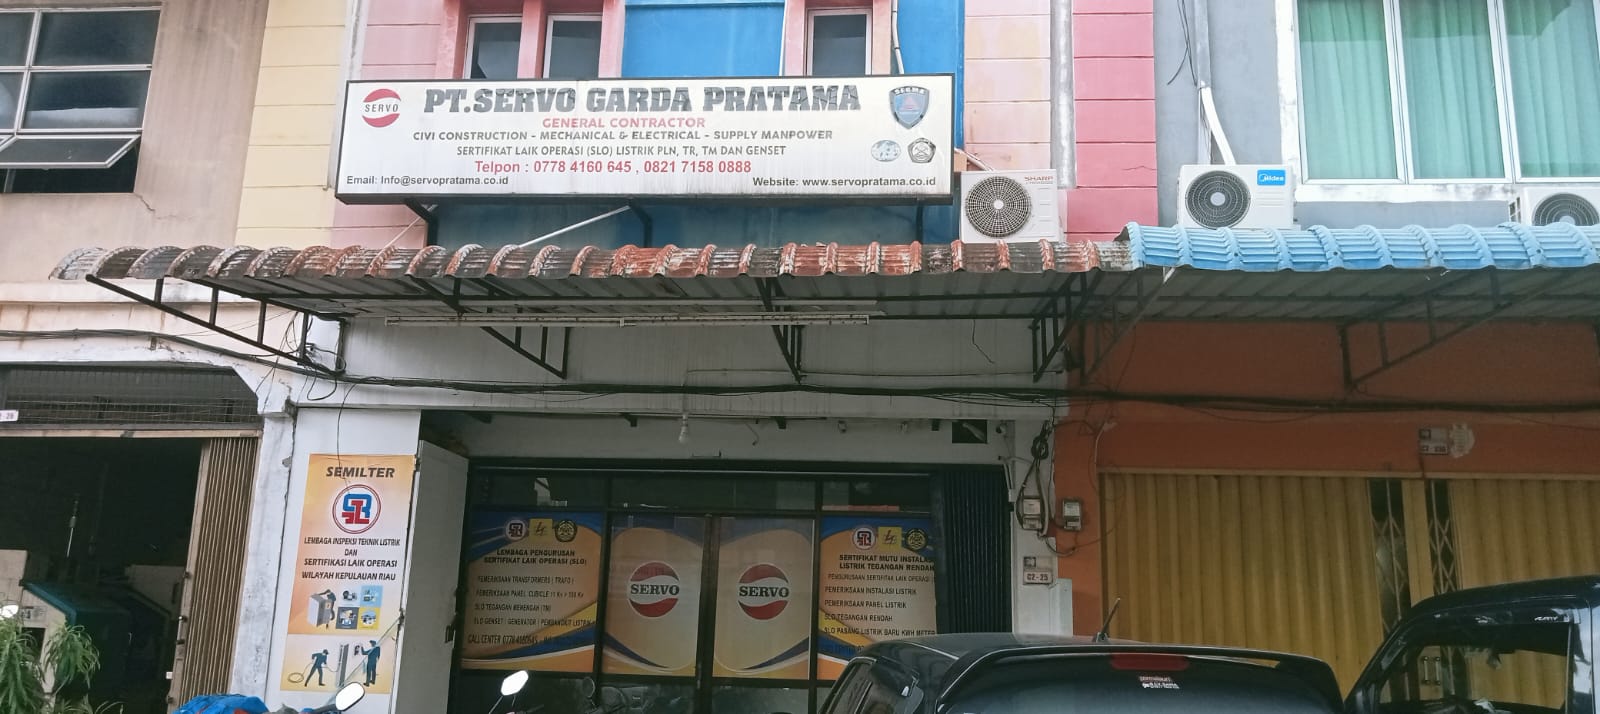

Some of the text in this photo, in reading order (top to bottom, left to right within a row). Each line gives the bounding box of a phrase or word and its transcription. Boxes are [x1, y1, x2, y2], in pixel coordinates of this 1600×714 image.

[424, 85, 861, 113] PT.SERVO GARDA PRATAMA
[364, 103, 399, 114] SERVO
[542, 117, 706, 128] GENERAL CONTRACTOR
[413, 131, 435, 141] CIVI
[439, 131, 528, 141] CONSTRUCTION
[540, 131, 616, 141] MECHANICAL
[618, 131, 629, 140] &
[632, 131, 701, 140] ELECTRICAL
[714, 130, 758, 140] SUPPLY
[761, 130, 833, 140] MANPOWER
[457, 145, 787, 157] SERTIFIKAT LAIK OPERASI (SLO) LISTRIK PLN, TR, TM DAN GENSET
[475, 160, 521, 175] Telpon
[534, 161, 566, 173] 0778
[570, 161, 603, 173] 4160
[607, 161, 632, 173] 645
[644, 160, 676, 173] 0821
[682, 160, 714, 173] 7158
[718, 160, 752, 173] 0888
[346, 175, 509, 186] Email: Info@servopratama.co.id
[752, 177, 936, 188] Website: www.servopratama.co.id
[326, 466, 395, 479] SEMILTER
[304, 537, 401, 546] LEMBAGA INSPEKSI TEKNIK LISTRIK
[344, 548, 358, 556] DAN
[496, 549, 528, 557] LEMBAGA
[304, 558, 398, 568] SERTIFIKASI LAIK OPERASI
[521, 557, 537, 565] LAIK
[538, 557, 569, 565] OPERASI
[839, 554, 879, 562] SERTIFIKAT
[879, 554, 898, 562] MUTU
[867, 563, 904, 571] TEGANGAN
[301, 571, 396, 581] WILAYAH KEPULAUAN RIAU
[630, 584, 680, 596] SERVO
[739, 585, 790, 598] SERVO
[825, 586, 917, 596] PEMERIKSAAN INSTALASI LISTRIK
[885, 601, 907, 609] LISTRIK
[468, 634, 481, 644] CALL
[481, 634, 502, 644] CENTER
